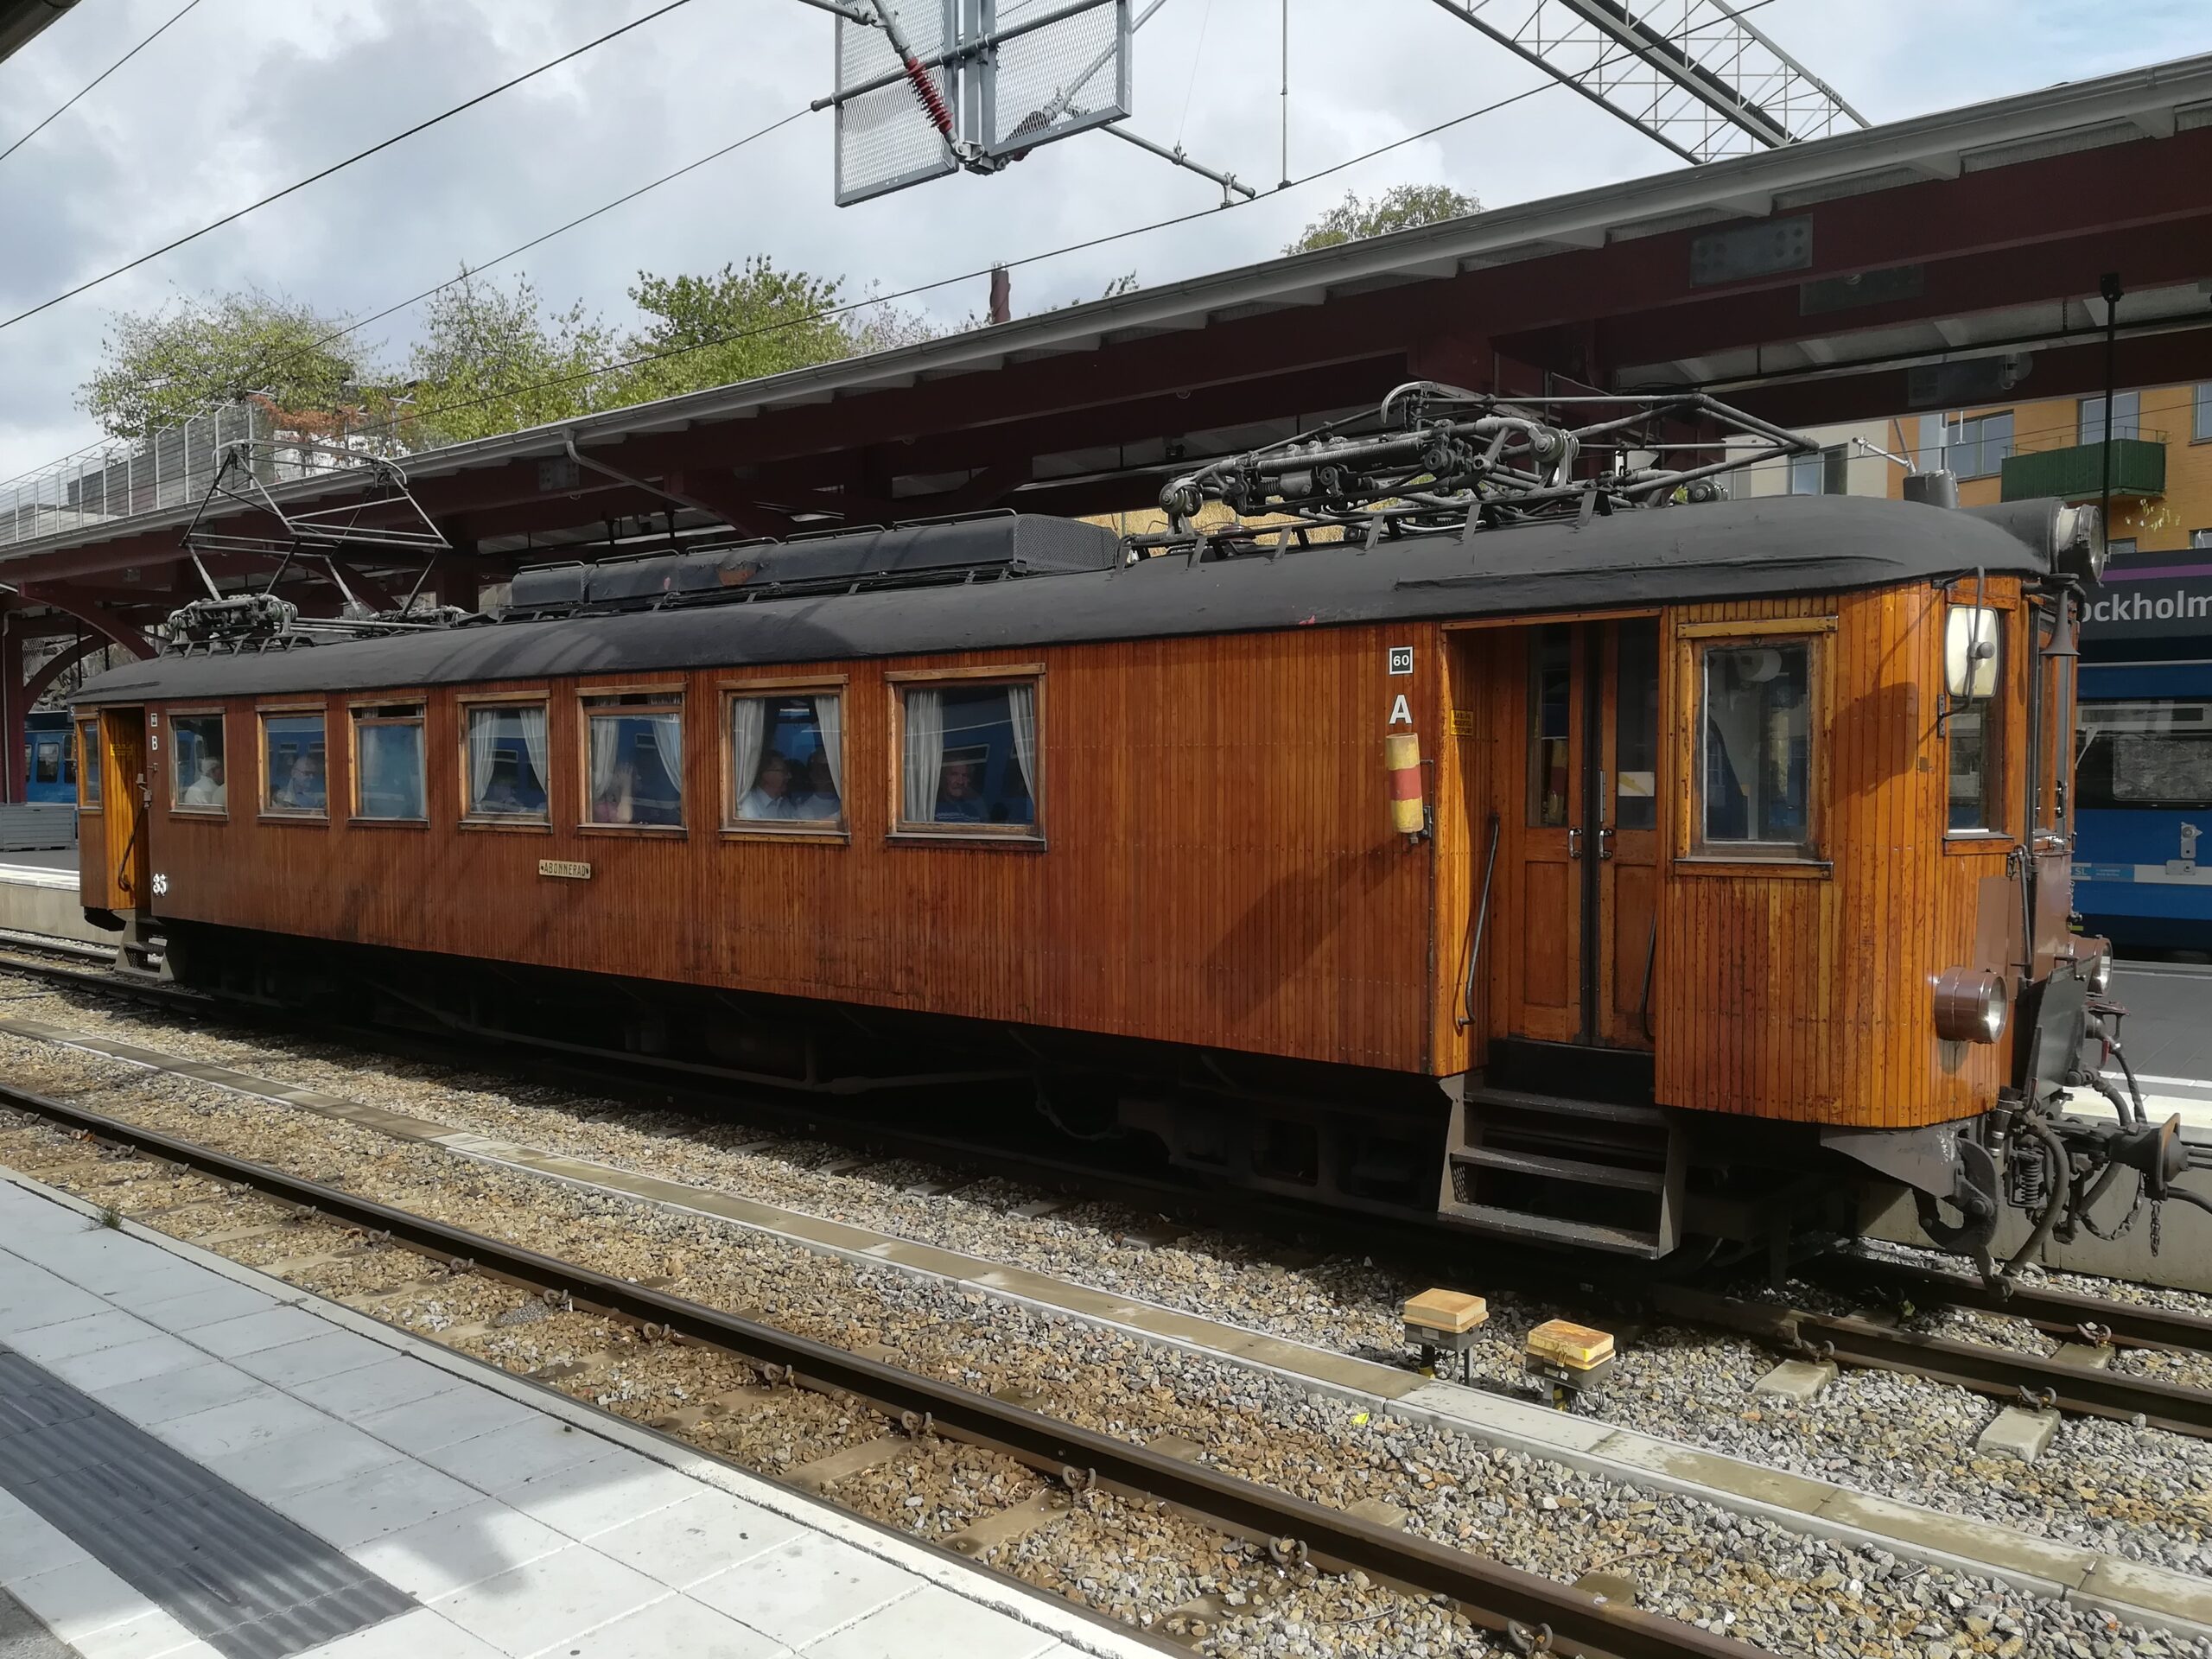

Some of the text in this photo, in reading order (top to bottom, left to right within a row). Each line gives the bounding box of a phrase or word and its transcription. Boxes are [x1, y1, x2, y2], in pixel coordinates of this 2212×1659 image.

[2082, 589, 2212, 623] ockholm
[1393, 655, 1410, 667] 60
[1389, 694, 1413, 724] A
[152, 735, 158, 750] B
[543, 861, 586, 877] ABONNERAD
[2075, 867, 2088, 875] SL
